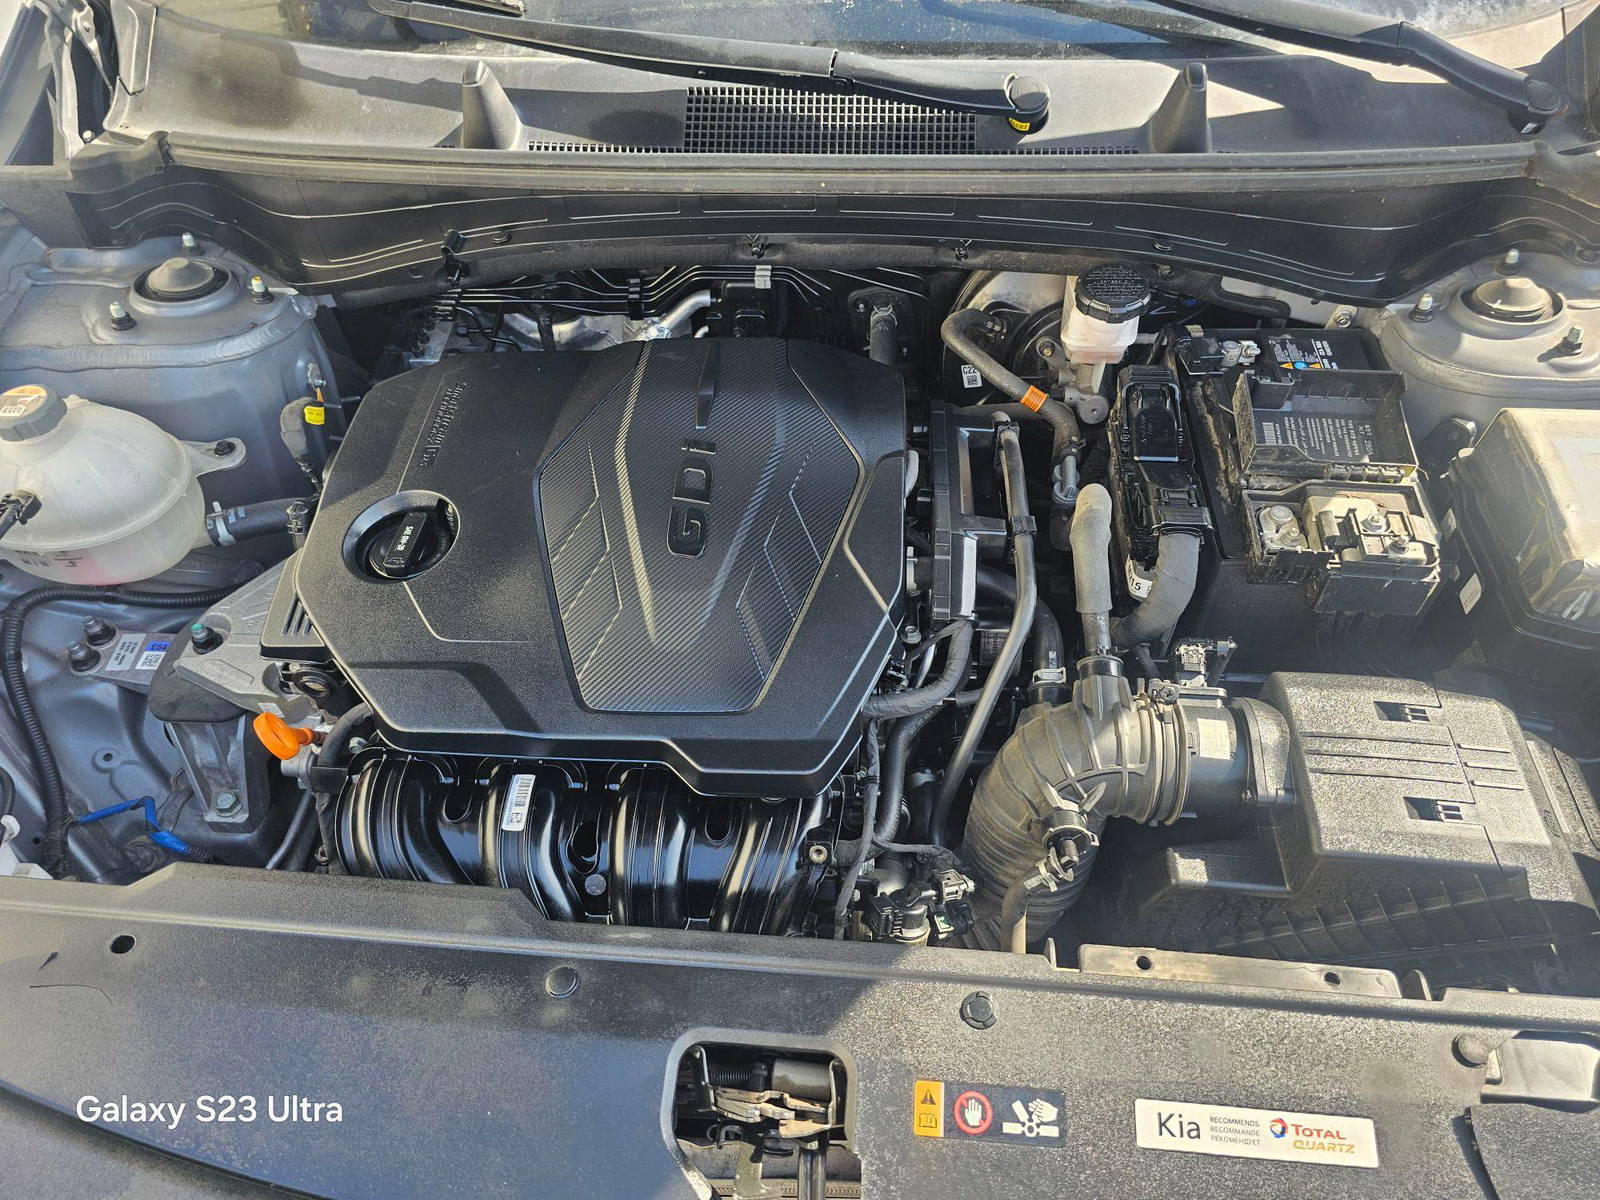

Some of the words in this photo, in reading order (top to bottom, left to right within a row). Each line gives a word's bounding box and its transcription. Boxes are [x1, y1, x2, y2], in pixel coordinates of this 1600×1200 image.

[403, 525, 414, 536] SAE
[1157, 1112, 1201, 1140] Kia
[1209, 1116, 1260, 1127] RECOMMENDS
[1210, 1126, 1260, 1137] RECOMMANDE
[1290, 1123, 1347, 1140] TOTAL
[1210, 1135, 1260, 1146] РЕКОМЕНДУЕТ
[1292, 1140, 1355, 1154] QUARTZ
